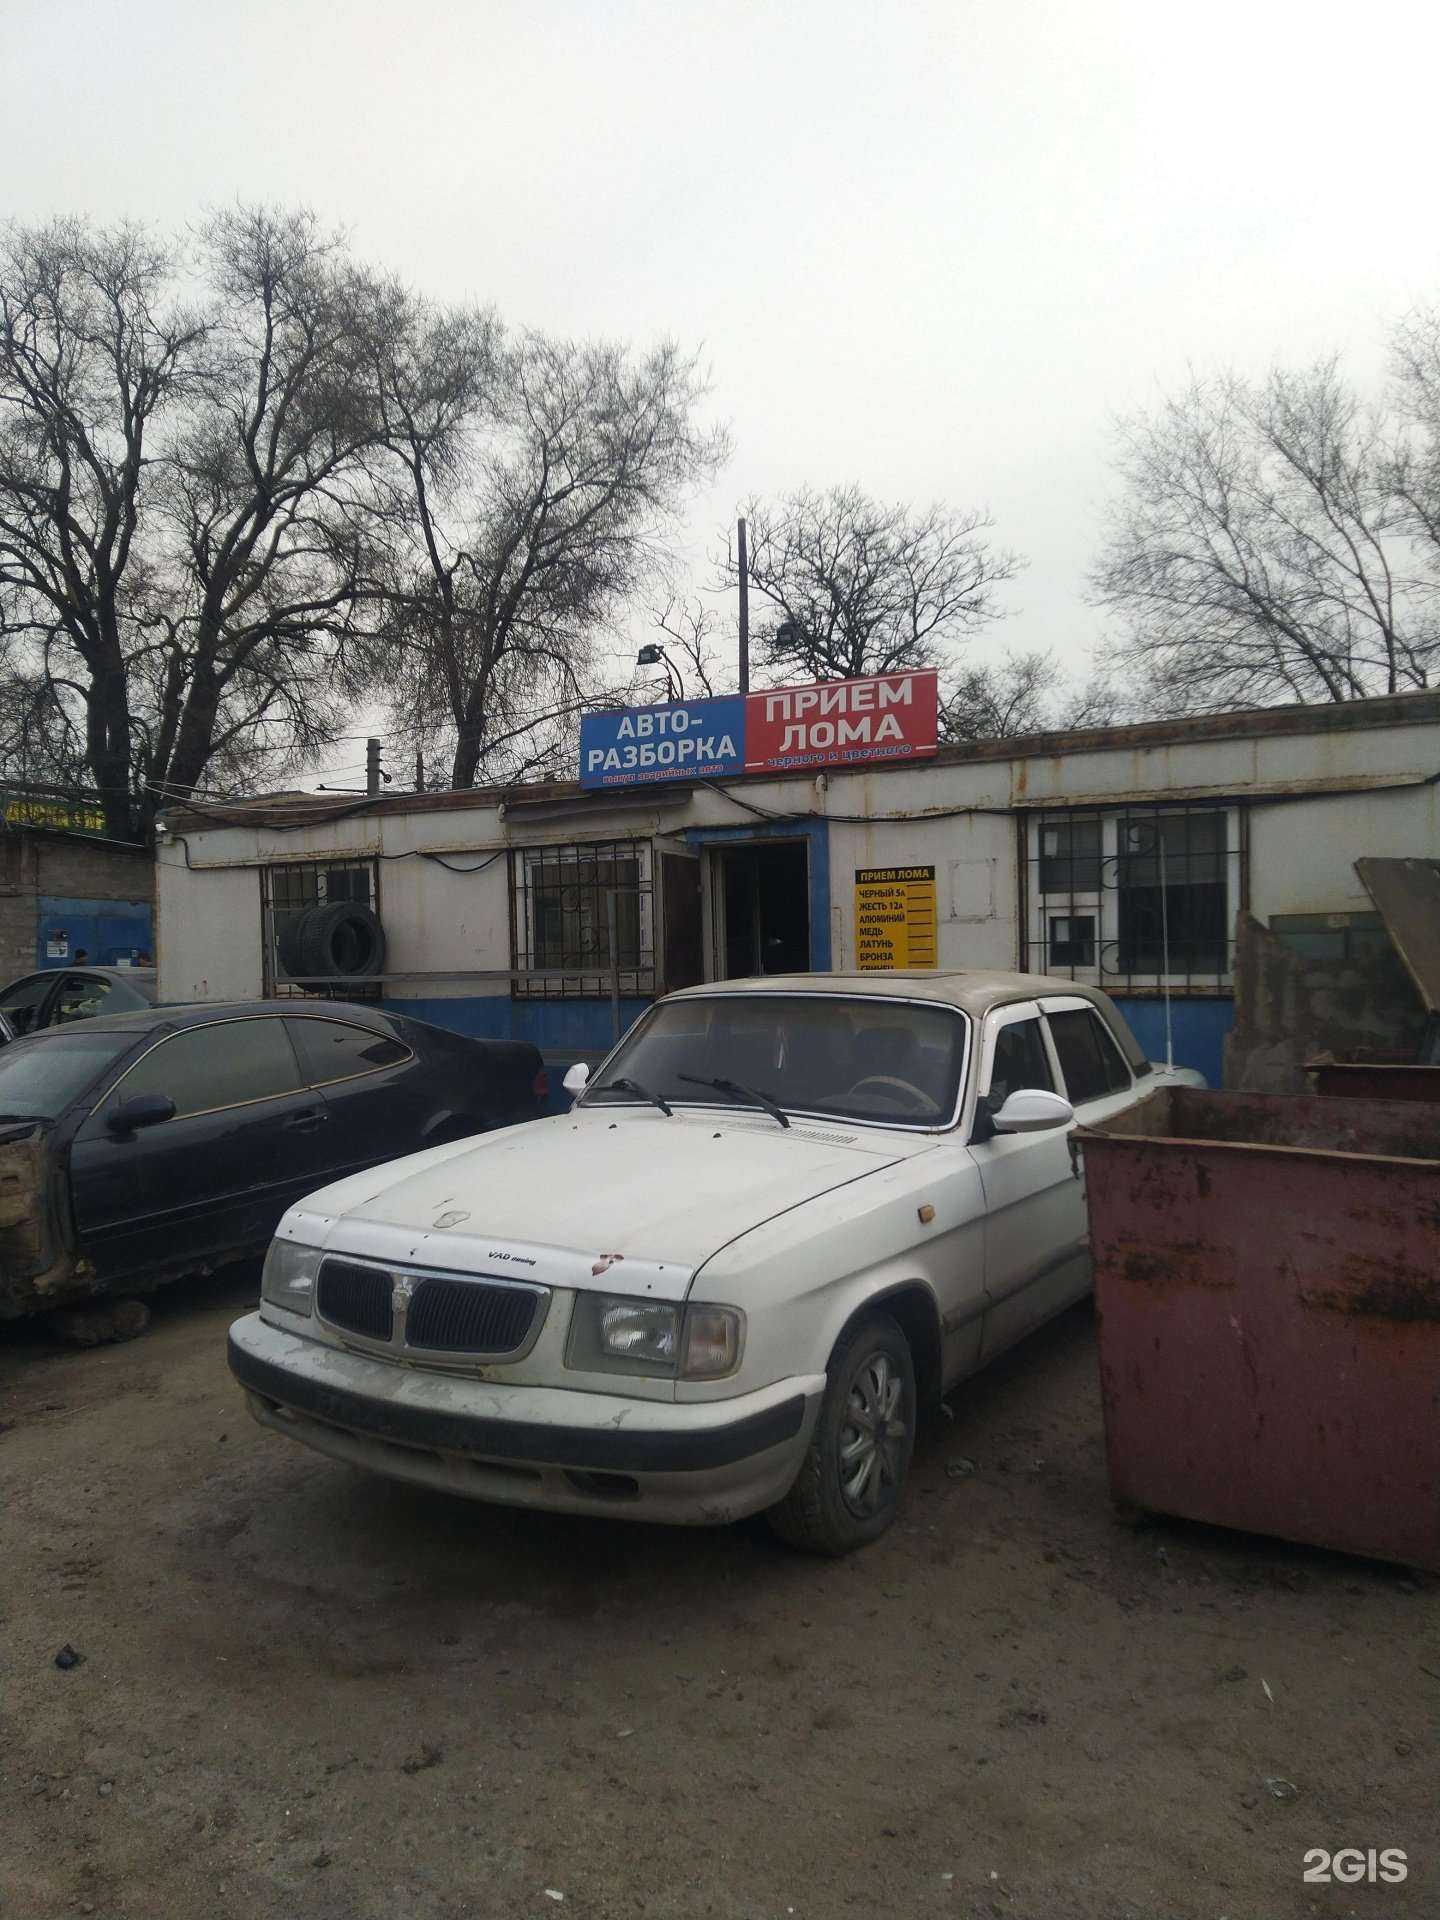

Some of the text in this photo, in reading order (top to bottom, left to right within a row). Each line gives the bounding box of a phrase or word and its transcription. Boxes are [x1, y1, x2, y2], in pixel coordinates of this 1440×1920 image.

[765, 677, 913, 723] ПРИЕМ
[616, 709, 703, 740] АВТО-
[779, 713, 905, 752] ЛОМА
[588, 735, 737, 772] РАЗБОРКА
[767, 744, 912, 768] черного и цветного
[860, 869, 929, 881] ПРИЕМ ЛОМА
[859, 888, 894, 898] ЧЕРНЫЙ
[859, 902, 888, 911] ЖЕСТЬ
[860, 914, 905, 923] АЛЮМИНИЙ
[859, 927, 883, 937] МЕДЬ
[859, 939, 894, 949] ЛАТУНЬ
[859, 952, 894, 961] БРОНЗА
